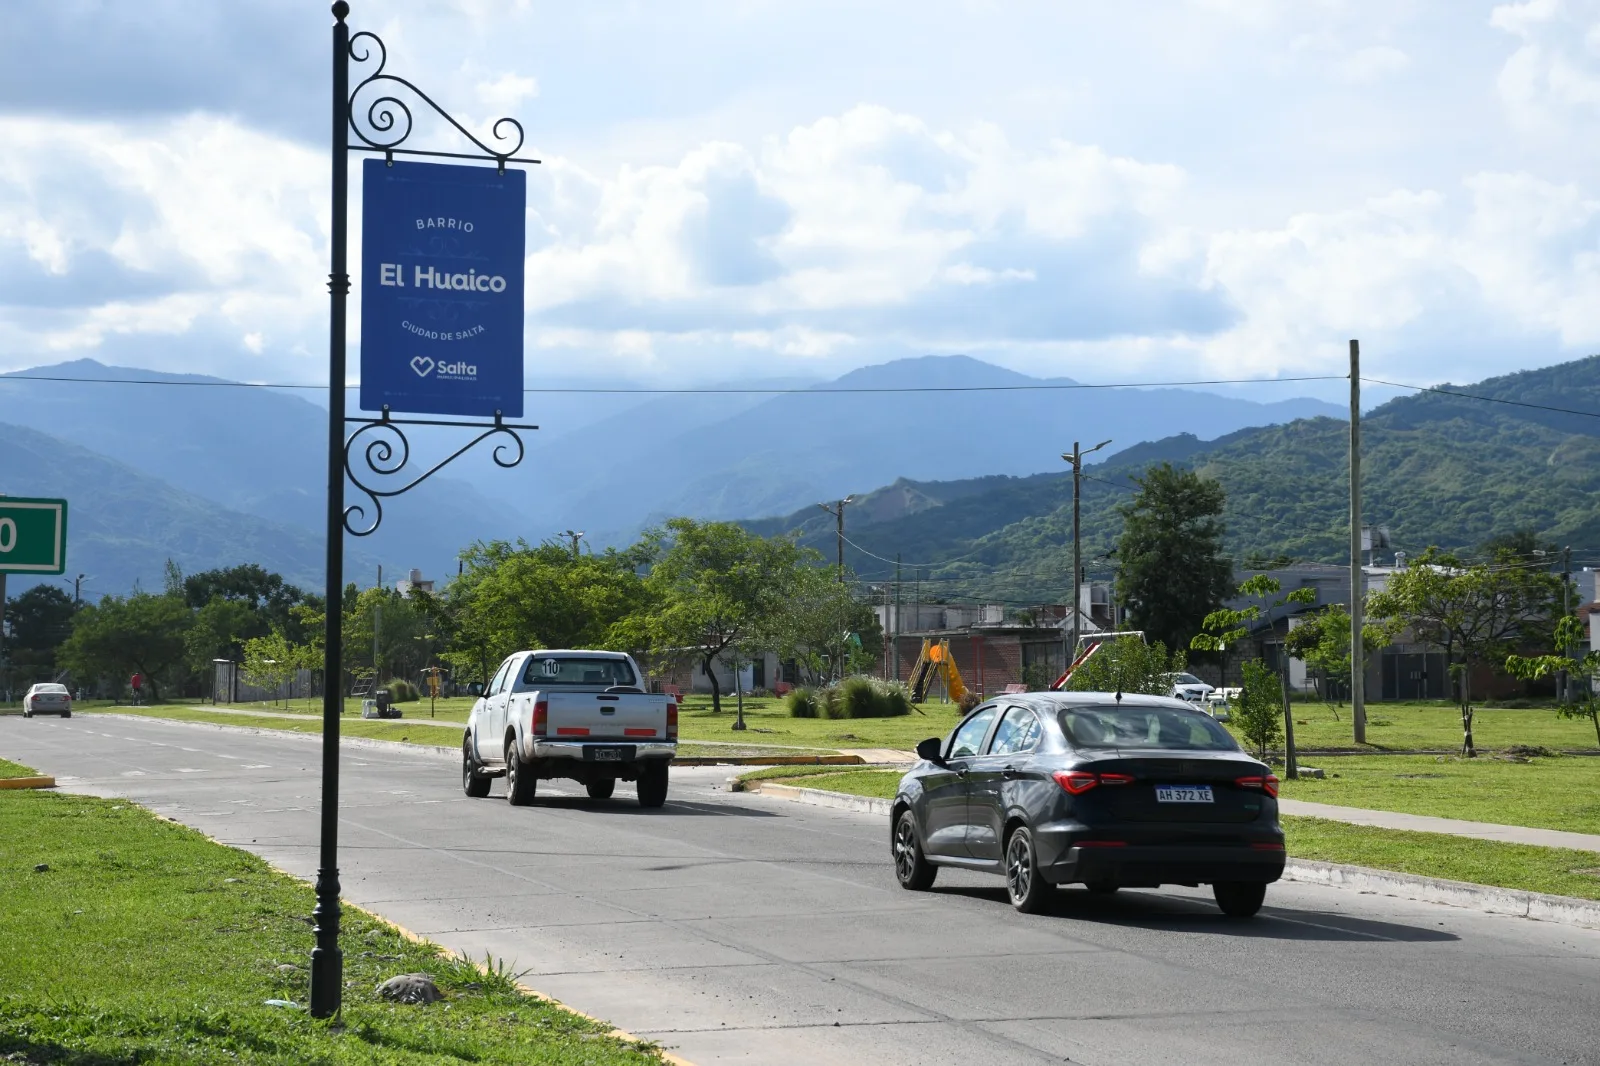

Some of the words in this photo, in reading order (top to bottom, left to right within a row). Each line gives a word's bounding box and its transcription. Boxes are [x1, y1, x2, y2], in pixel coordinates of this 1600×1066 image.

[416, 217, 474, 233] BARRIO
[380, 263, 404, 287] El
[415, 265, 507, 293] Huaico
[401, 320, 438, 340] CIUDAD
[440, 332, 453, 341] DE
[455, 324, 485, 340] SALTA
[437, 360, 477, 376] Salta
[543, 661, 558, 675] 110
[1159, 790, 1173, 801] AH
[1175, 790, 1196, 801] 372
[1198, 790, 1212, 801] XE
